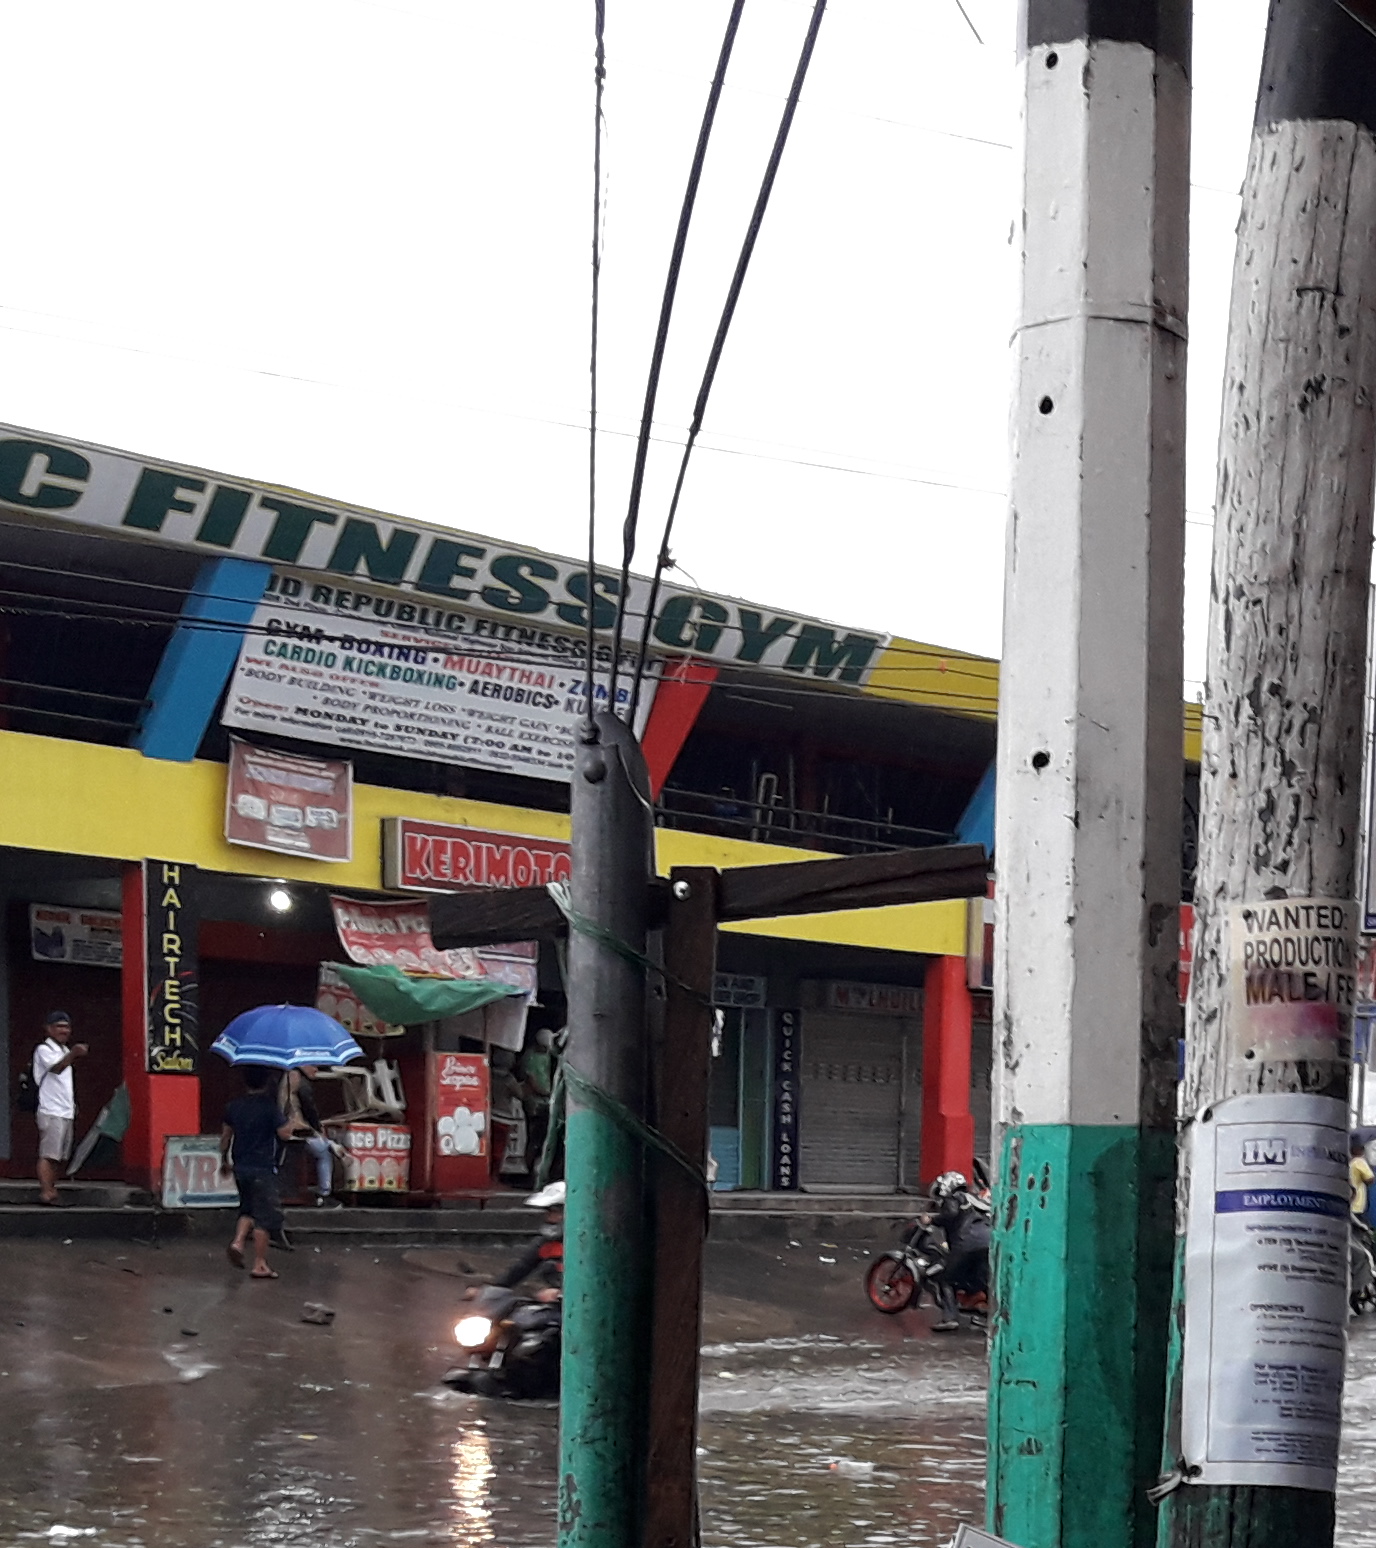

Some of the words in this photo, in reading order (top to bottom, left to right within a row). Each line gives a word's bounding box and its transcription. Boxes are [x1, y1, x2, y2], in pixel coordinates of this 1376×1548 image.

[120, 466, 625, 629] FITNESS
[652, 595, 879, 686] GYM
[311, 584, 467, 632] REPUBLIC
[263, 639, 337, 669] CARDIO
[342, 651, 458, 691] KICKBOXING
[468, 679, 555, 710] AEROBICS
[339, 633, 428, 665] BOXING
[443, 654, 555, 689] MUAYTHAI
[294, 706, 370, 727] MONDAY
[393, 722, 460, 742] SUNDAY
[161, 863, 182, 1047] HAIRTECH
[781, 1011, 795, 1073] QUICK
[780, 1080, 793, 1125] CASH
[779, 1132, 793, 1188] LOANS
